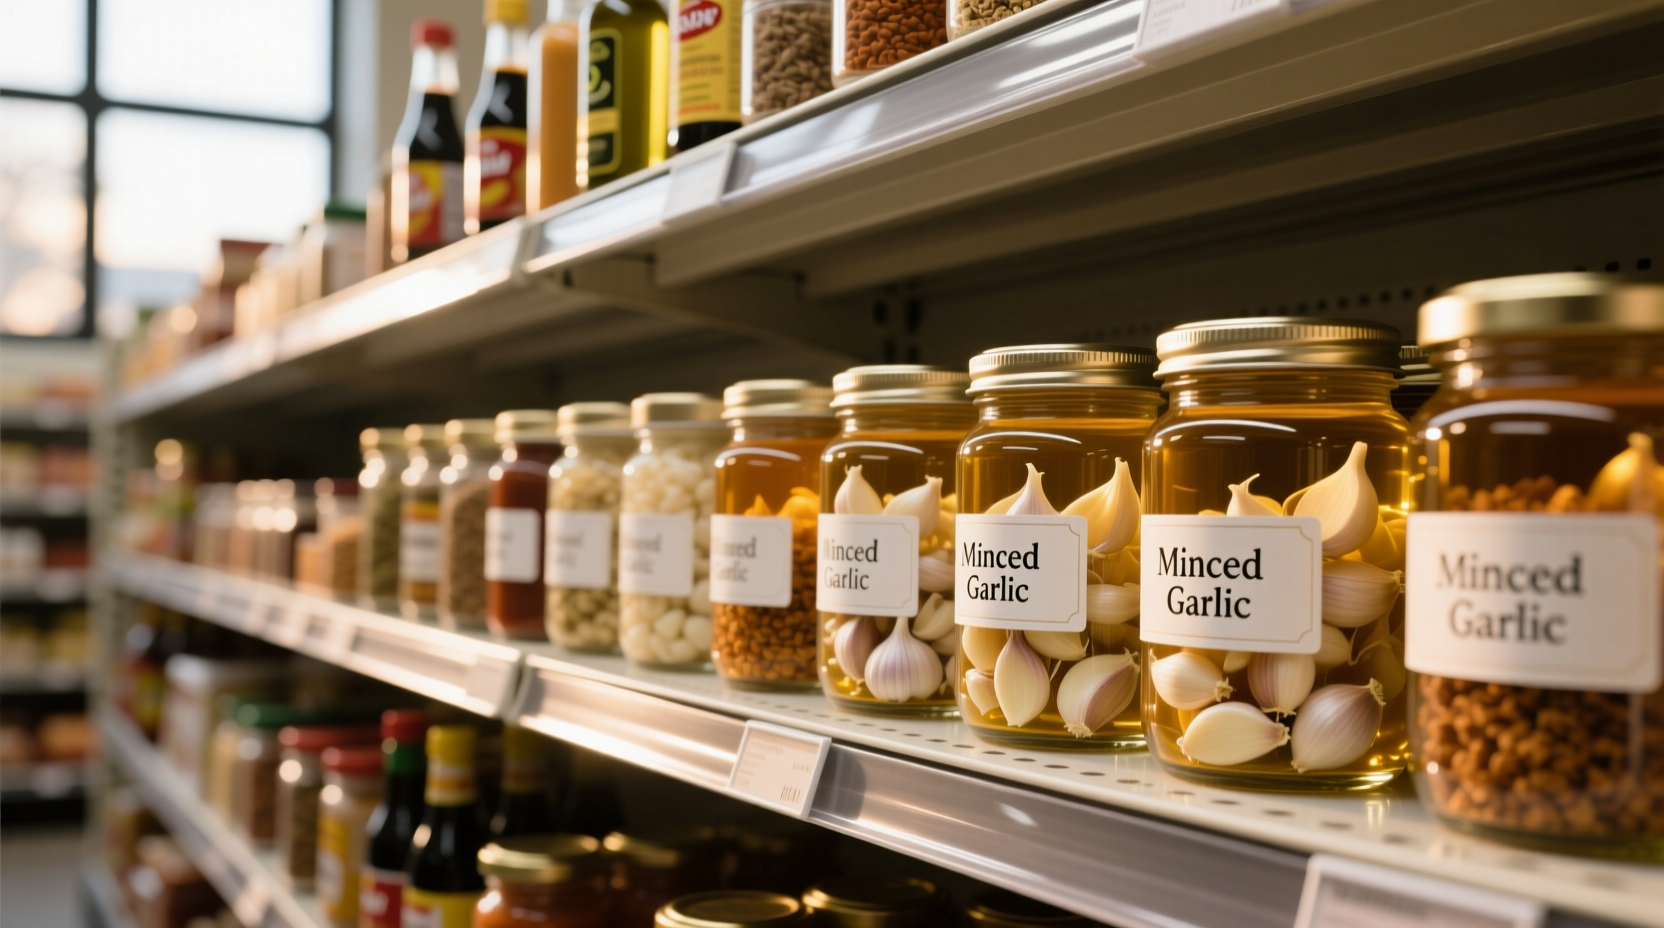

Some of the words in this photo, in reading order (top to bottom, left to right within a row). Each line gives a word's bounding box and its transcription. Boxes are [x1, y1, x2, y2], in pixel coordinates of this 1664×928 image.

[960, 542, 1040, 570] Minced
[1157, 546, 1264, 582] Minced
[824, 566, 870, 591] Garlic
[966, 575, 1029, 603] Garlic
[1436, 552, 1583, 596] Minced
[1166, 585, 1251, 620] Garlic
[1449, 599, 1567, 646] Garlic
